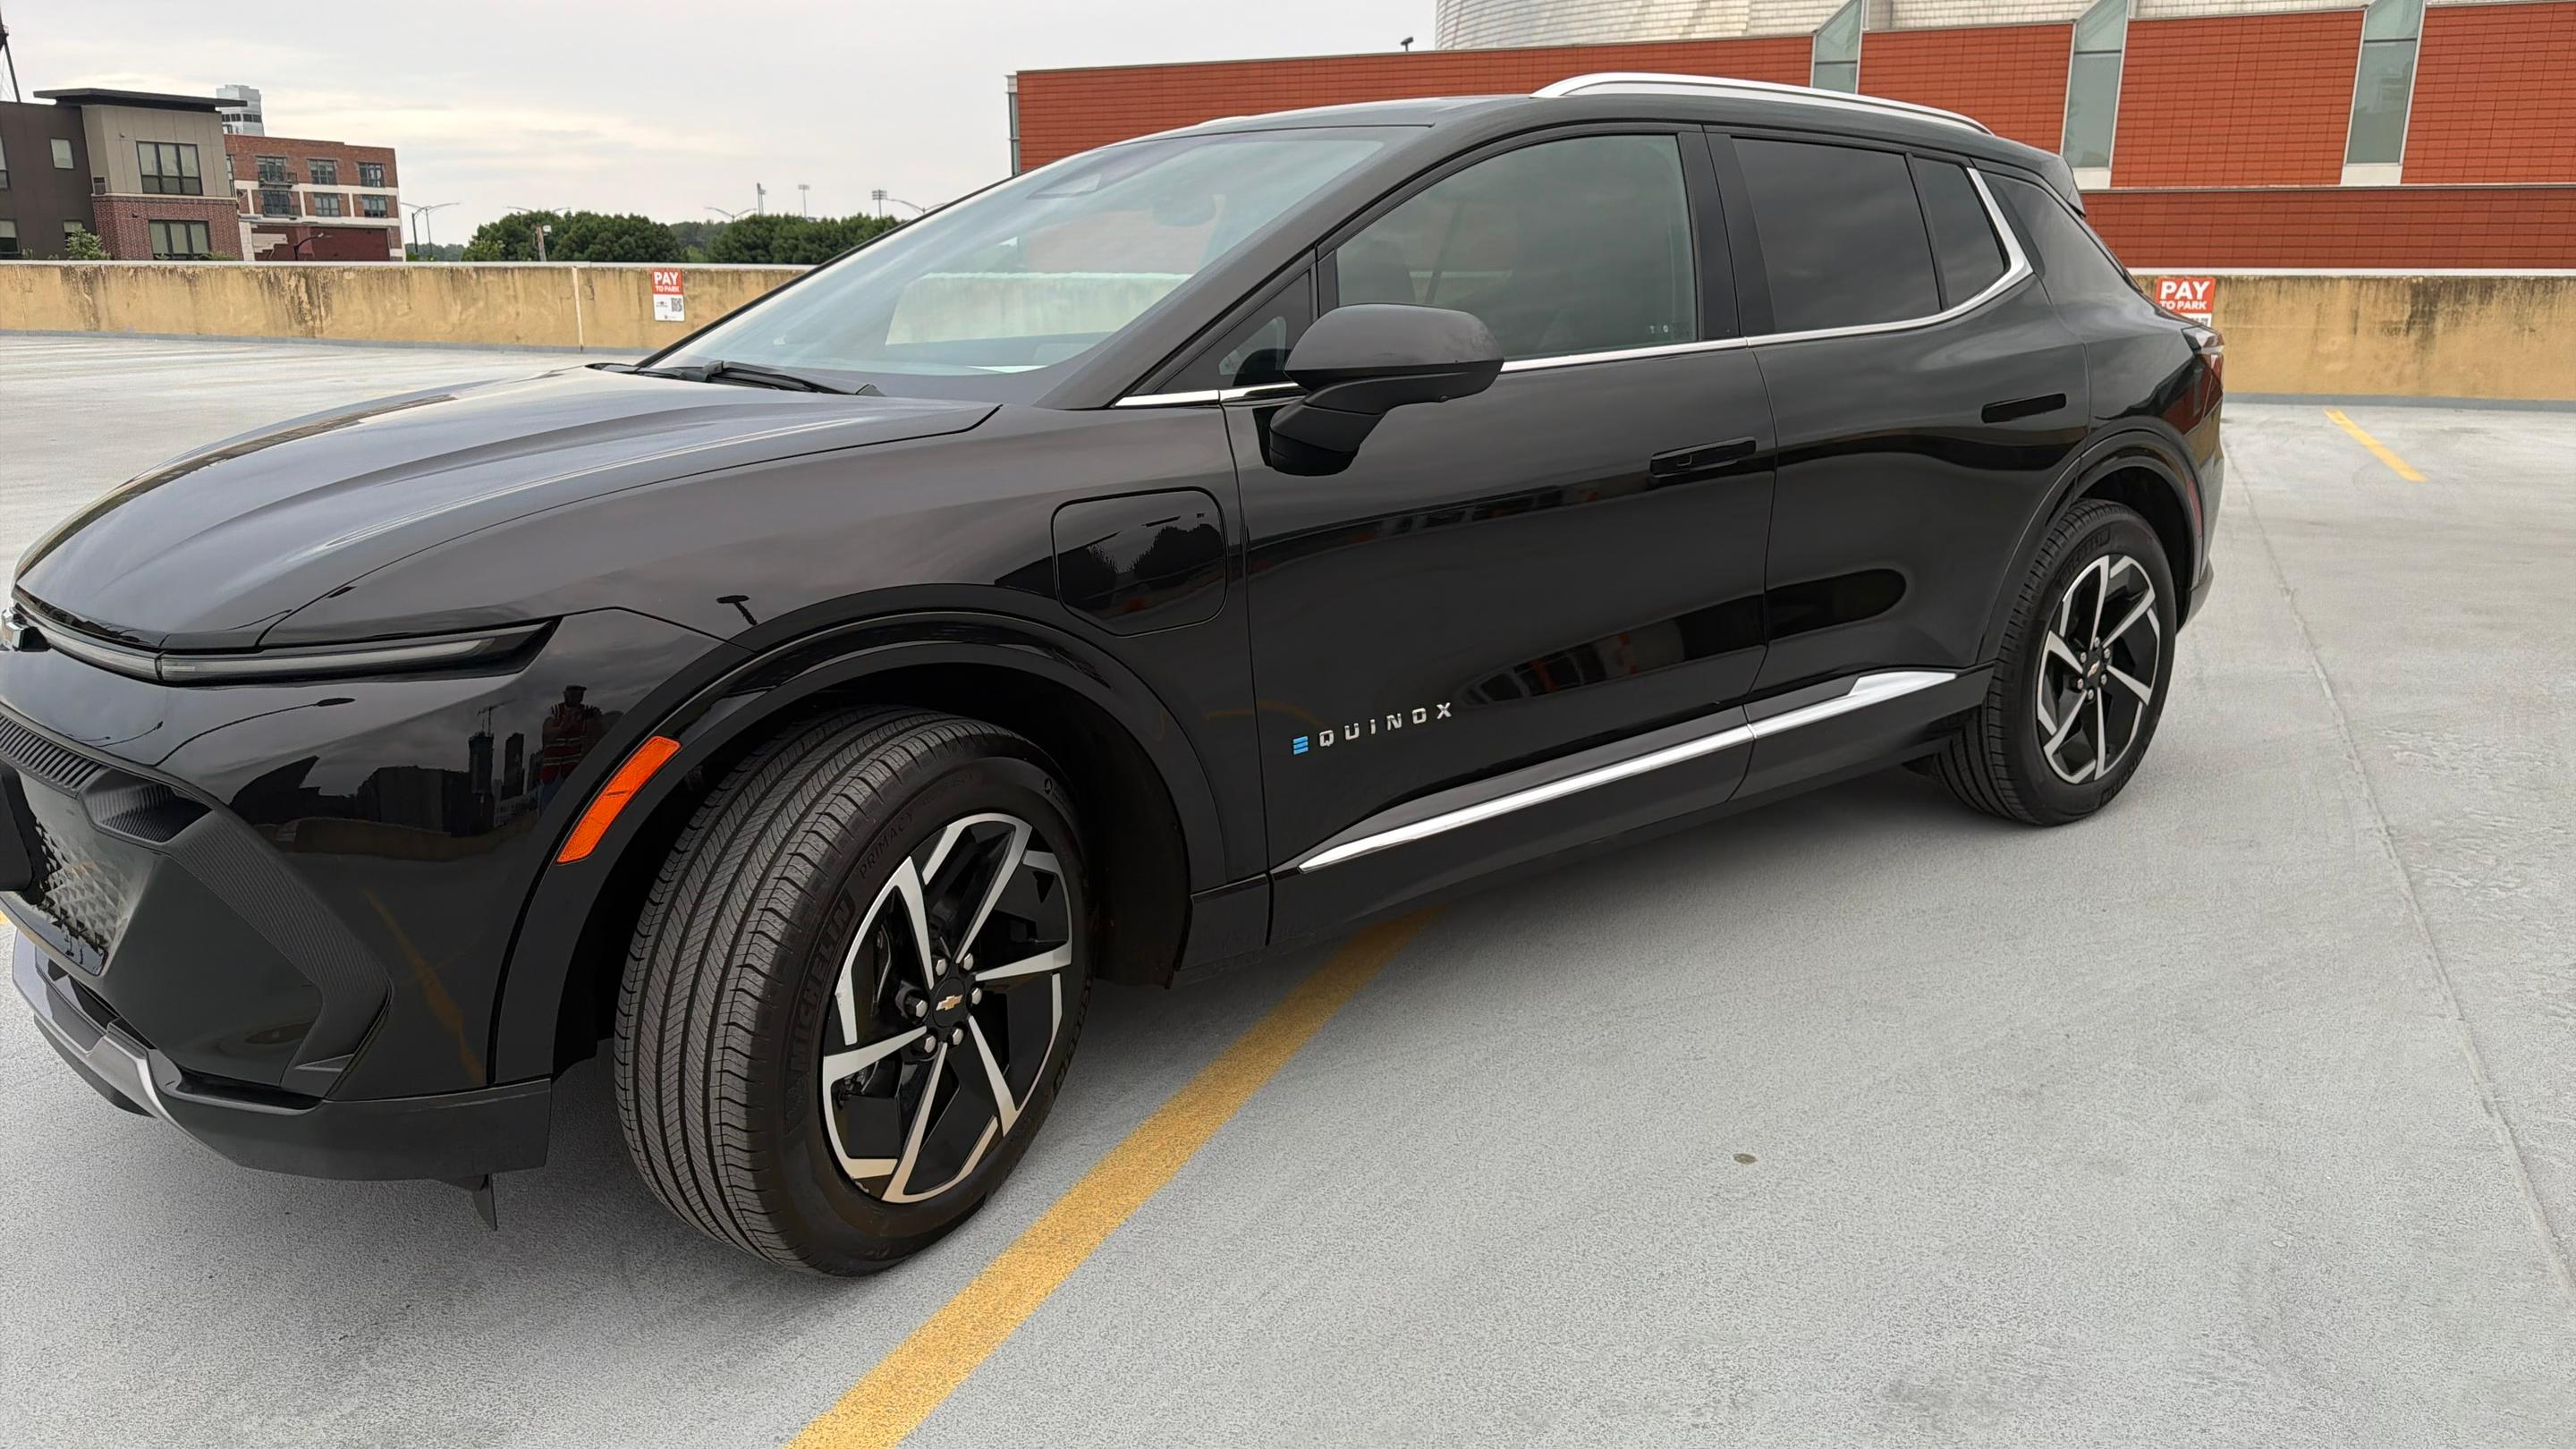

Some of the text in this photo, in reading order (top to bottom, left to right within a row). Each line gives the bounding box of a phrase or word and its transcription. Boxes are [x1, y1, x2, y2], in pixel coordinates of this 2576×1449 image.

[654, 271, 678, 285] PAY
[2160, 281, 2211, 300] PAY
[2160, 300, 2207, 310] TO PARK
[1292, 702, 1453, 755] EQUINOX
[790, 898, 851, 1072] MICHELIN
